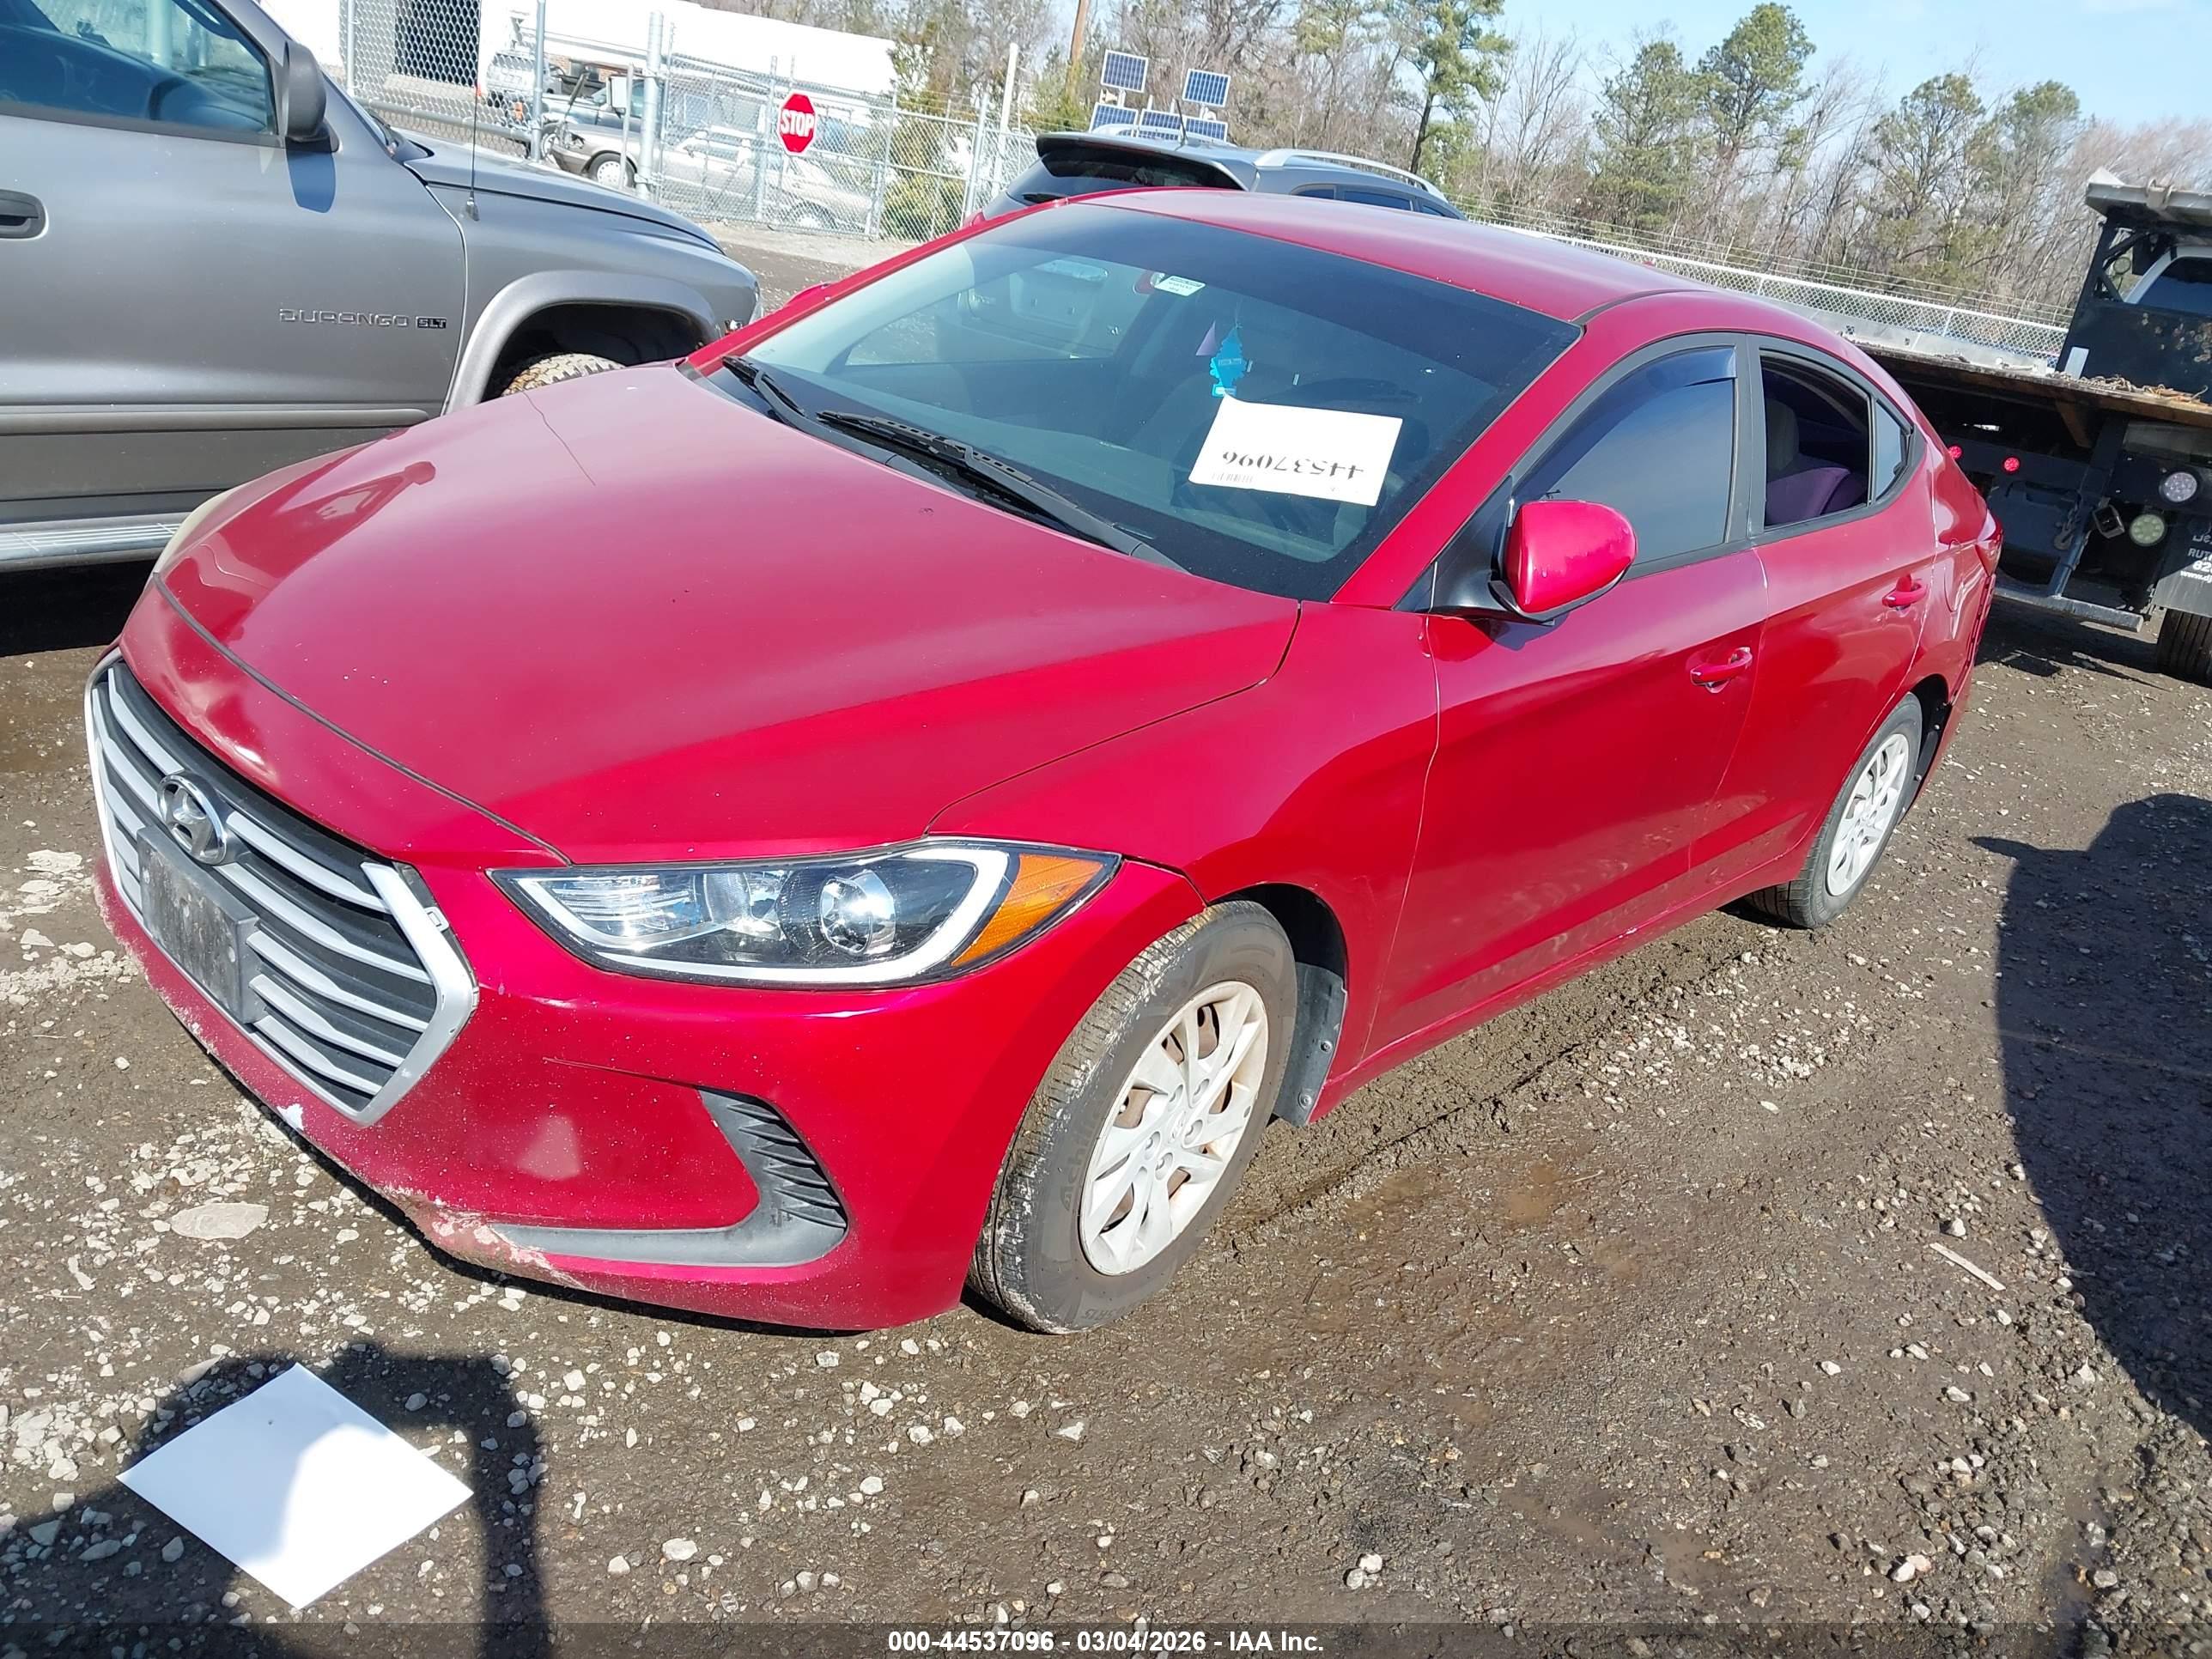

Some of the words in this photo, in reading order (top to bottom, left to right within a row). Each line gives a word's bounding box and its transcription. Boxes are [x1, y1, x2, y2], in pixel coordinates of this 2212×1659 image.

[780, 109, 815, 137] STOP
[279, 308, 409, 327] DURANGO
[417, 318, 447, 329] SLT
[1222, 451, 1364, 480] 44537096
